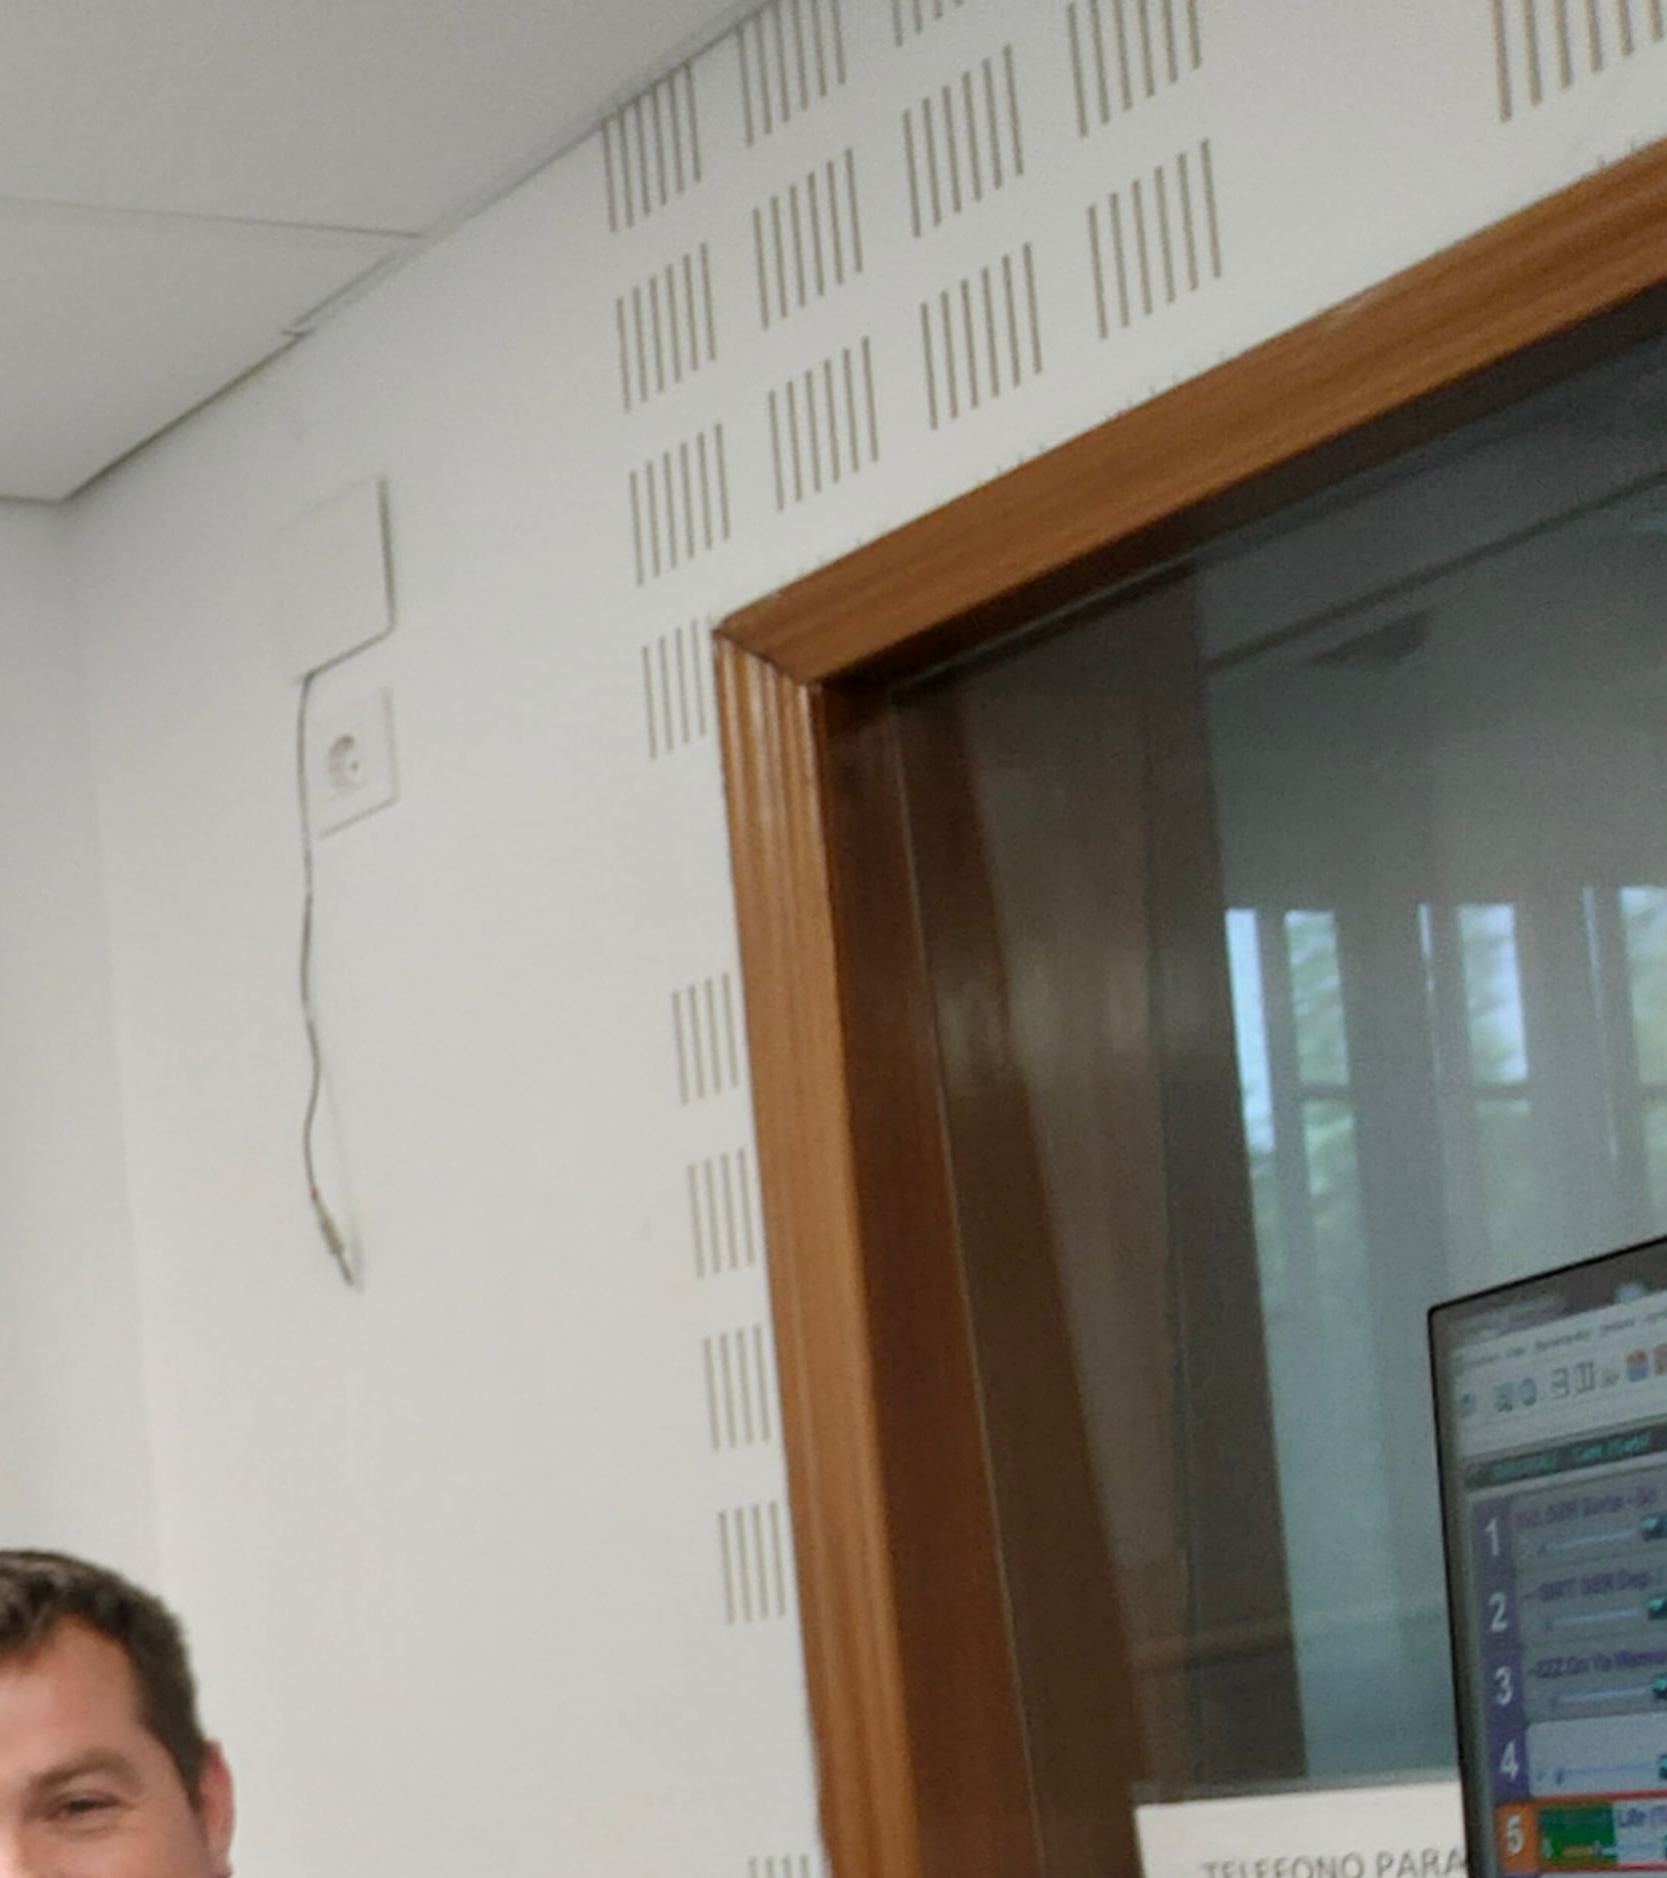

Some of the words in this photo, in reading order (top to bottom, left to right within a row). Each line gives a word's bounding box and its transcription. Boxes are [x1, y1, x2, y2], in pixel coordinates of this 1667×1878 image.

[1485, 1517, 1500, 1557] 1
[1489, 1592, 1508, 1633] 2
[1494, 1666, 1513, 1706] 3
[1500, 1741, 1519, 1782] 4
[1505, 1815, 1525, 1855] 5
